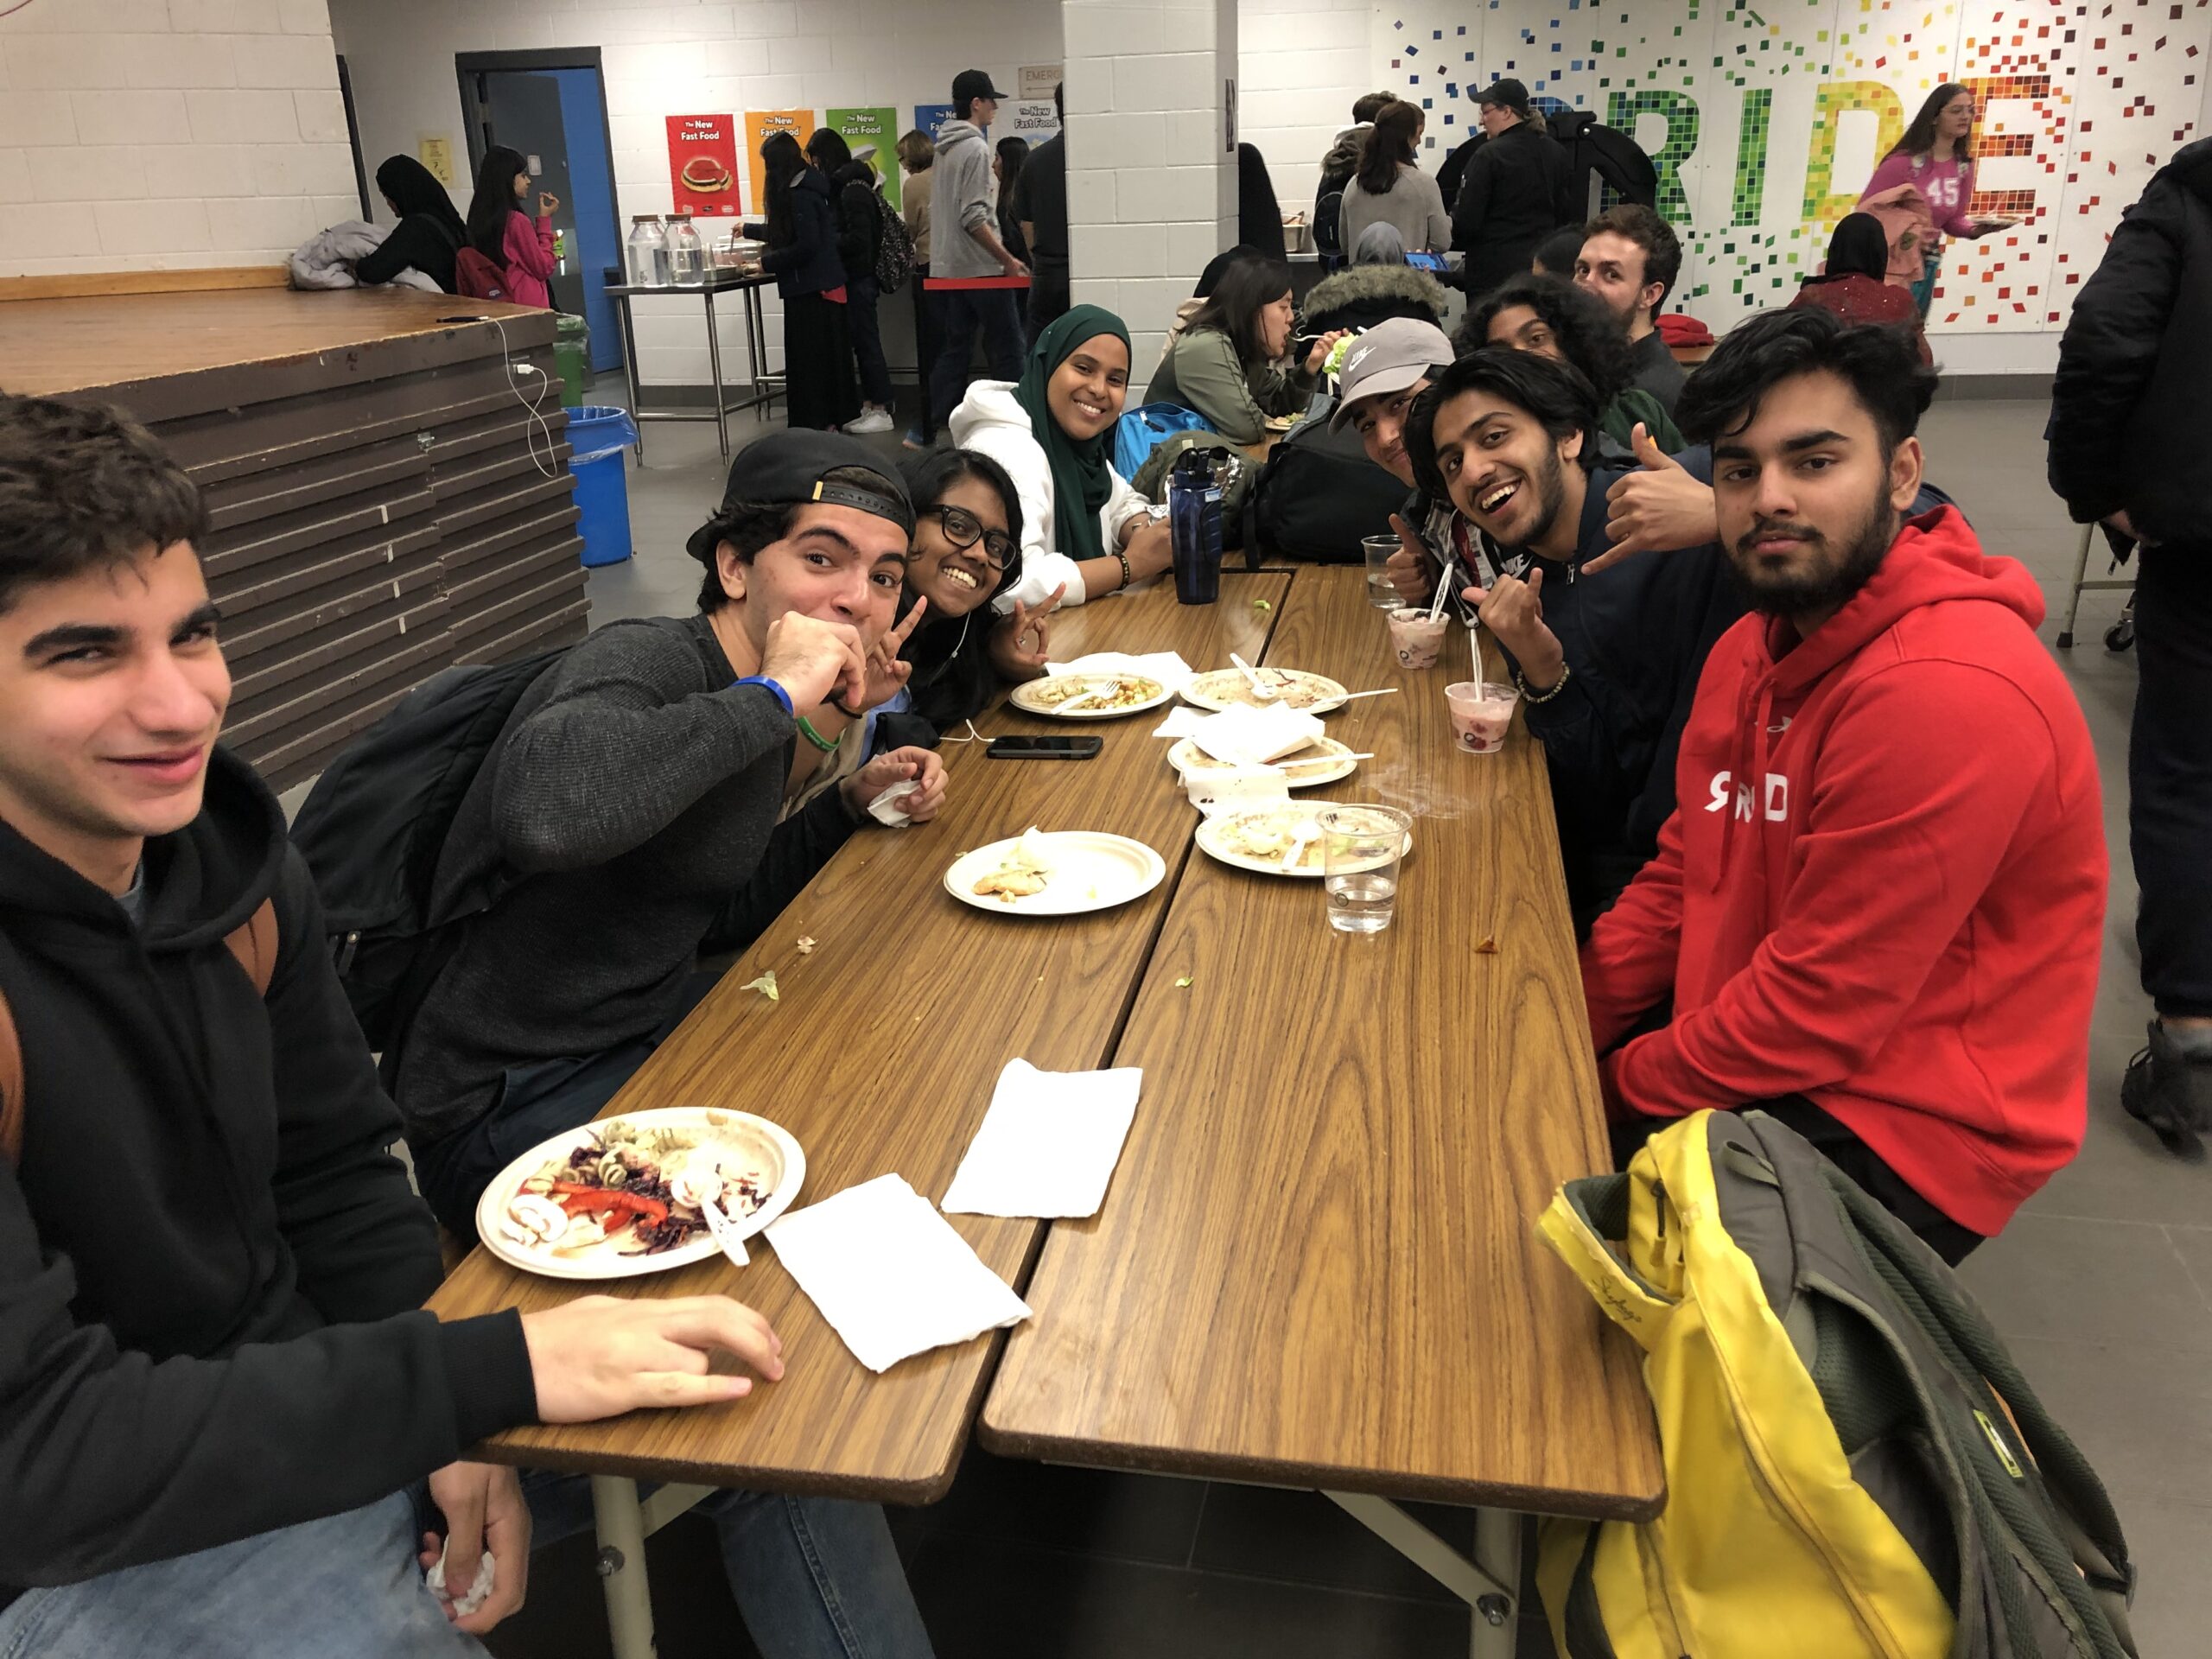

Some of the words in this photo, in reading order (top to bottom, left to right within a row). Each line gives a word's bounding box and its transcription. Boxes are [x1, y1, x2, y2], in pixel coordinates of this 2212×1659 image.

[945, 110, 957, 119] Ne
[1030, 105, 1051, 117] New
[774, 116, 793, 124] New
[856, 114, 875, 123] New
[1014, 118, 1035, 130] Fast
[1034, 117, 1057, 129] Food
[695, 120, 713, 129] New
[930, 122, 941, 132] Fa
[842, 126, 859, 135] Fast
[861, 125, 881, 134] Food
[681, 132, 698, 141] Fast
[699, 131, 720, 140] Food
[1529, 74, 2051, 227] RIDE
[1925, 177, 1960, 207] 45
